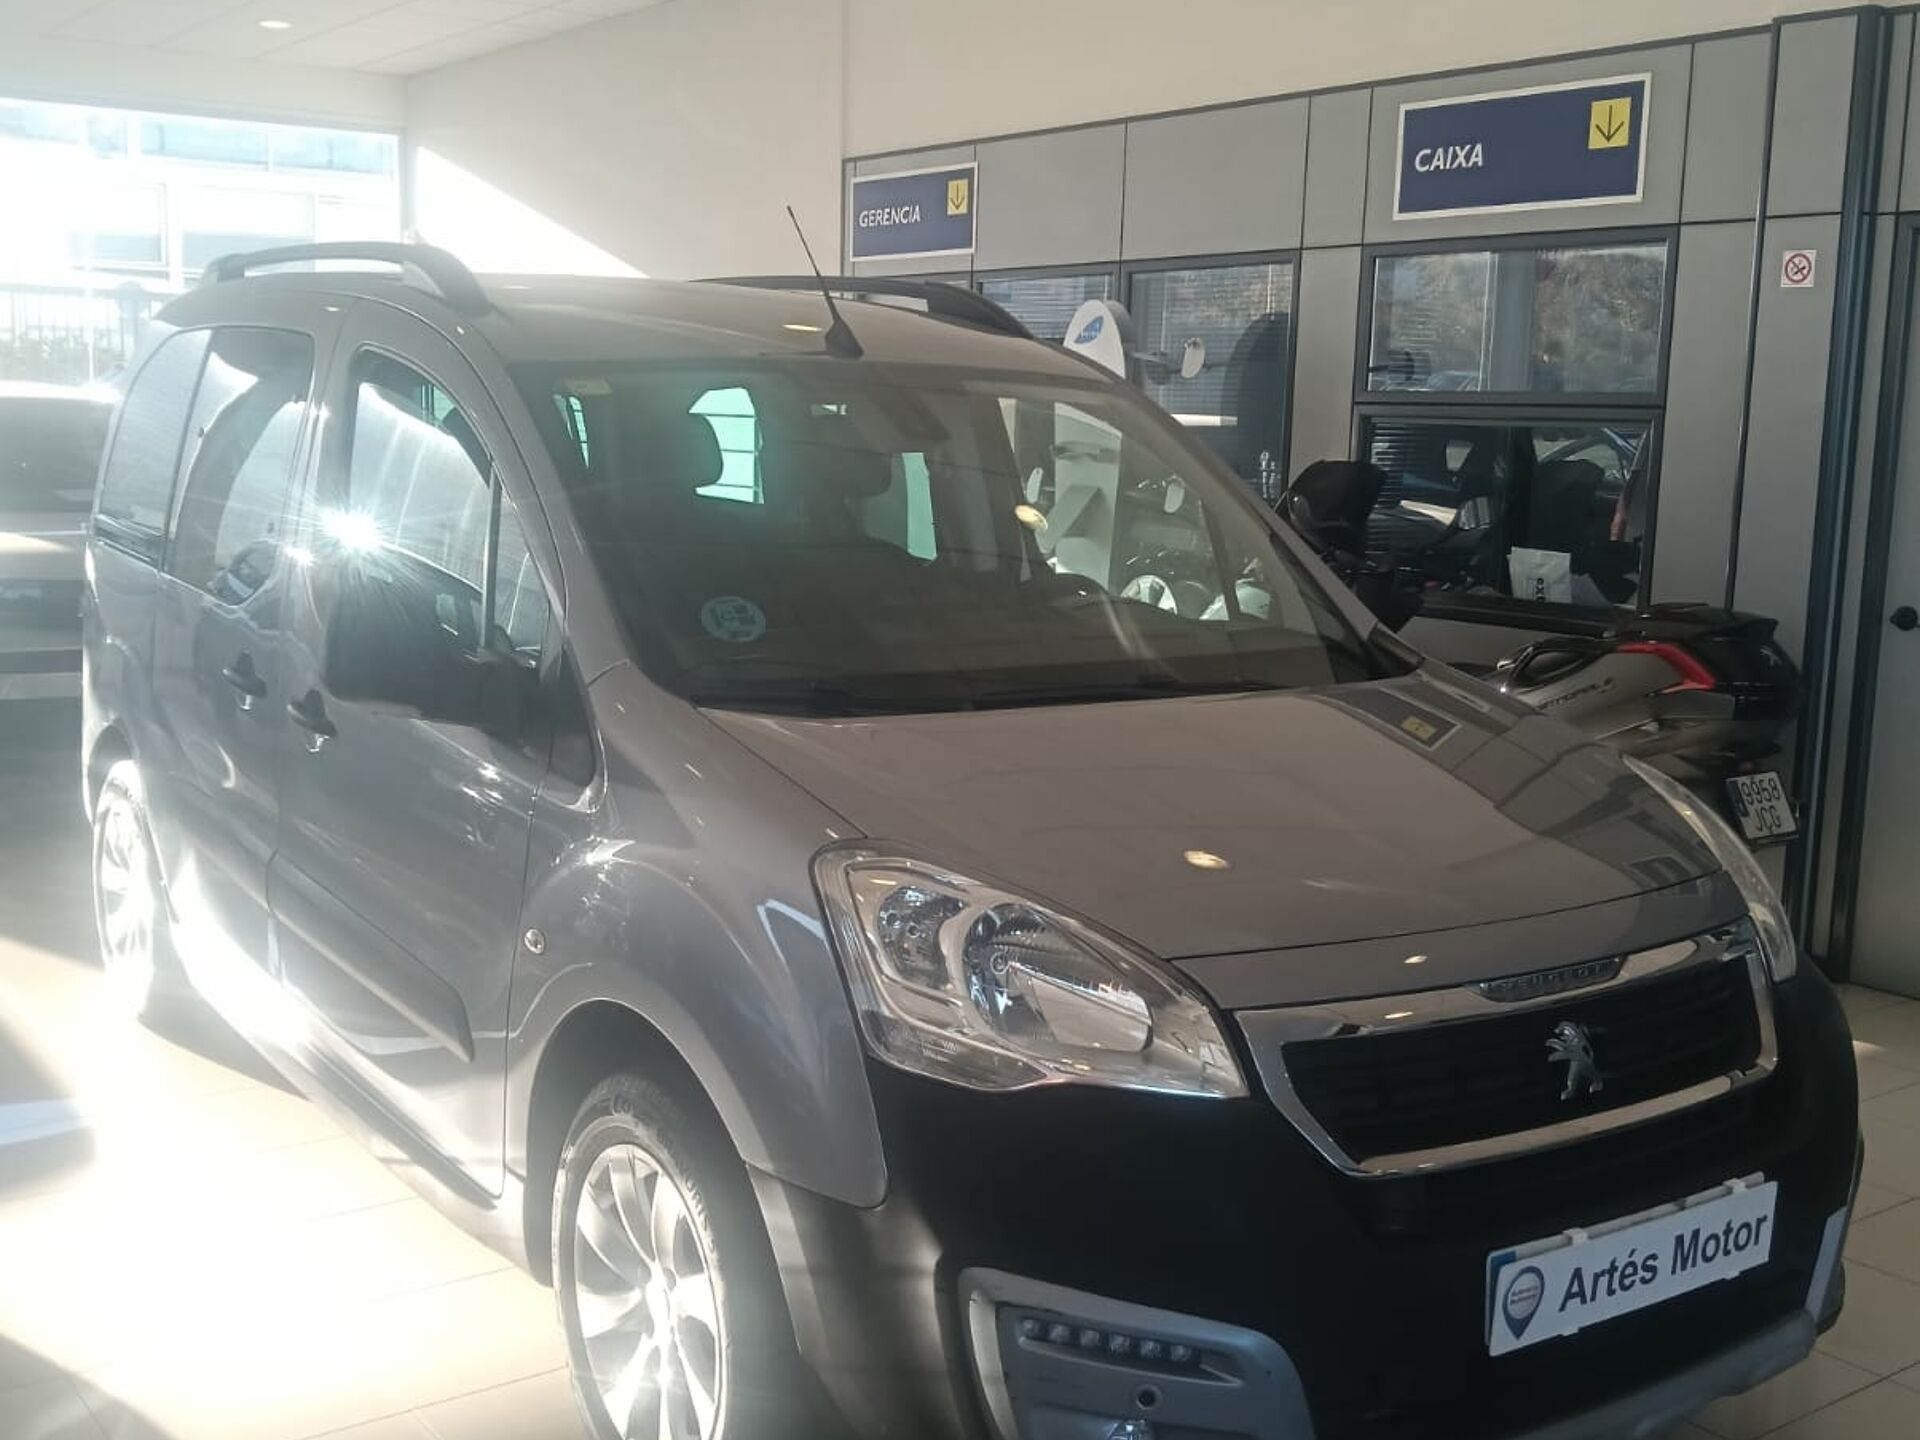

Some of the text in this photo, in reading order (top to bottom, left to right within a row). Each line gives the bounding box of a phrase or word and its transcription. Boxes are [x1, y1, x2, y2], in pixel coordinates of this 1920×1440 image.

[1415, 143, 1483, 172] CAIXA
[859, 205, 920, 228] GERENCIA
[1741, 777, 1780, 806] 9958
[1754, 805, 1781, 833] JCG
[1558, 1214, 1768, 1313] Artés Motor
